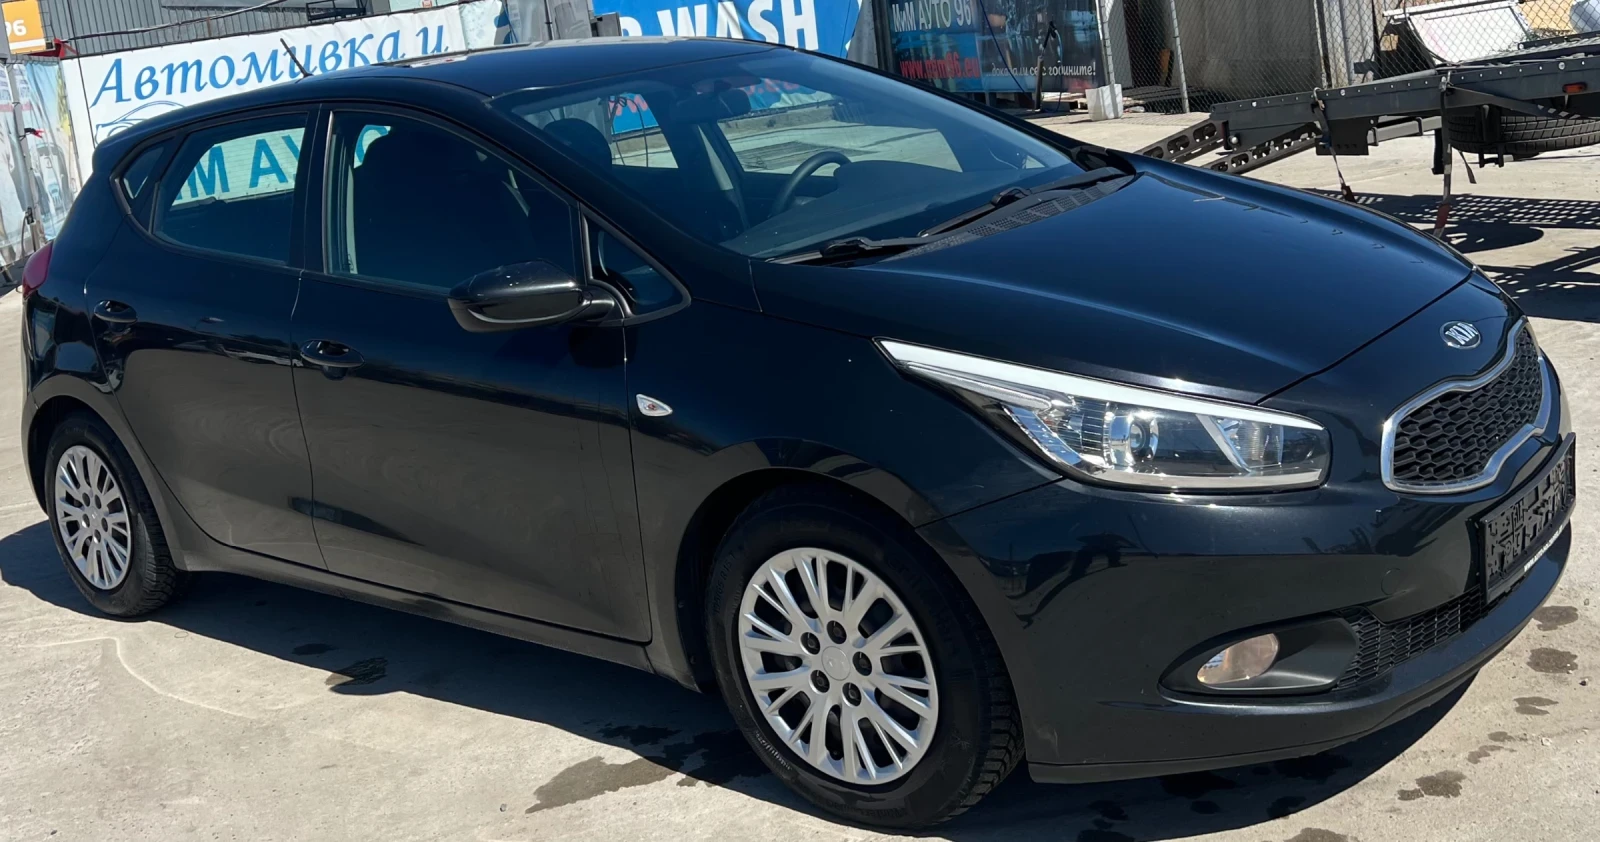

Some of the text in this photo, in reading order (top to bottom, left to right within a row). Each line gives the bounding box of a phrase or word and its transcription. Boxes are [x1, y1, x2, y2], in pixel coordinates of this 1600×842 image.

[656, 0, 819, 52] WASH
[918, 0, 952, 31] АУТО
[953, 0, 972, 27] 96
[90, 29, 406, 108] Автомивка
[415, 24, 449, 55] и
